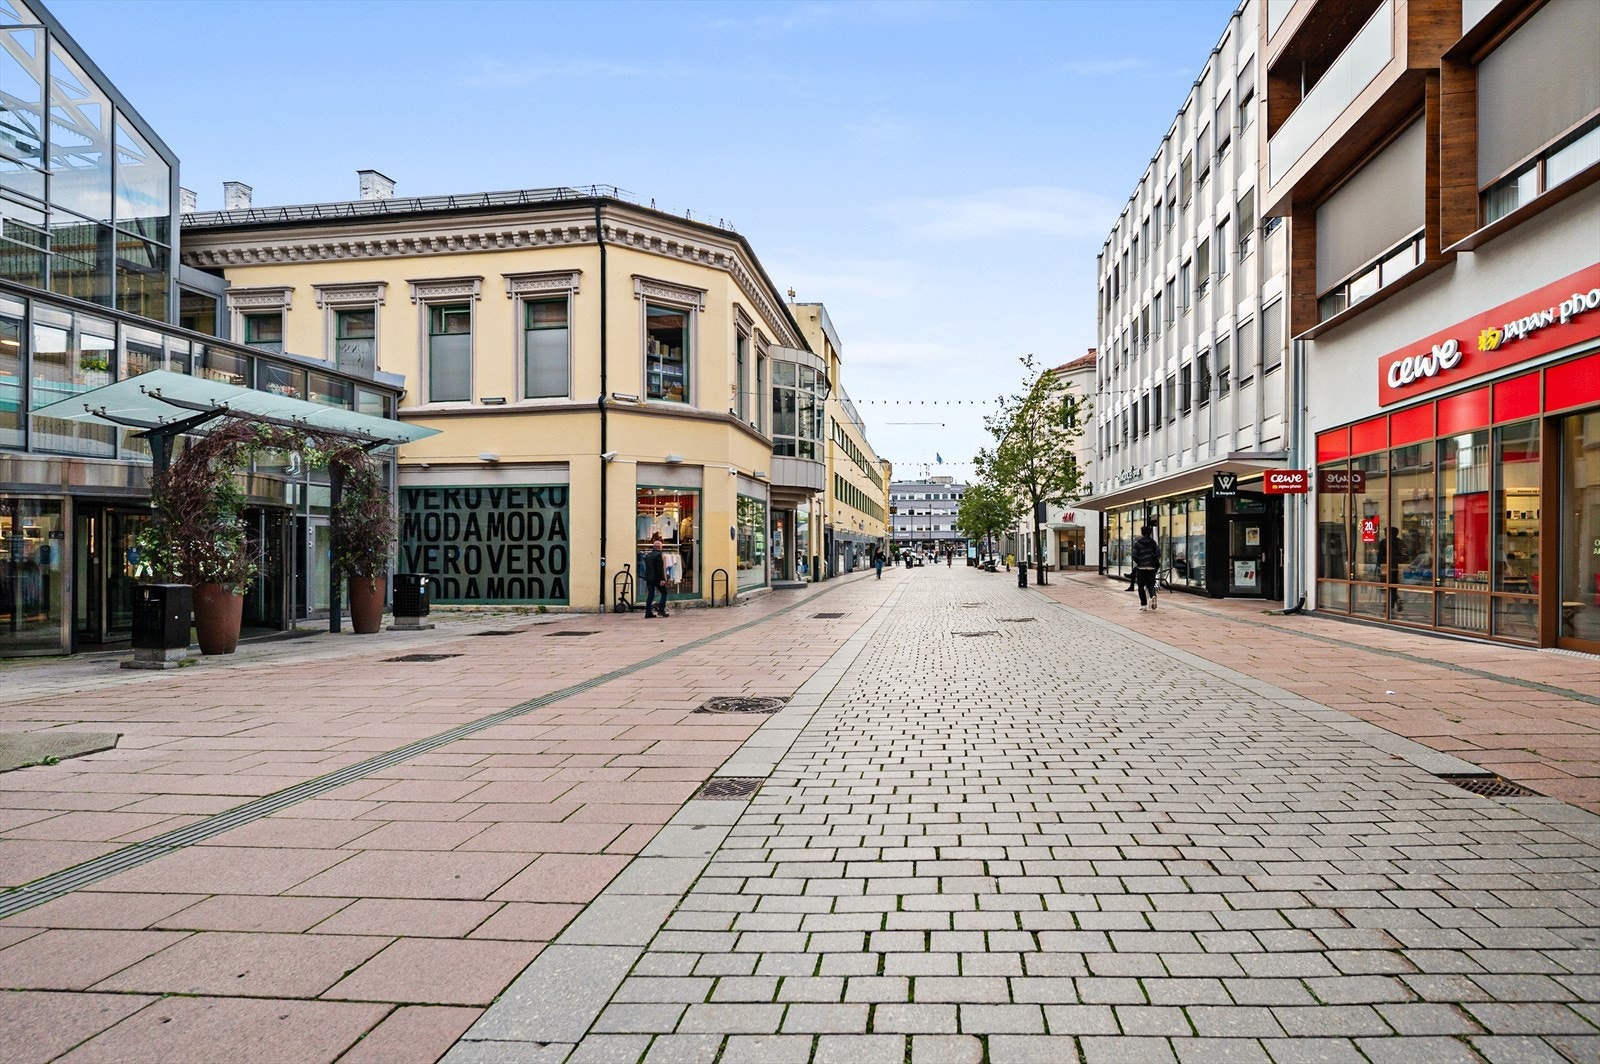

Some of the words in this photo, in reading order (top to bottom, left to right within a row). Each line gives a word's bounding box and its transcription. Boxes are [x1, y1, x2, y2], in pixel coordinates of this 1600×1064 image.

[1387, 339, 1463, 389] cewe
[1270, 474, 1304, 483] cewe
[403, 512, 483, 542] MODA
[486, 511, 567, 542] MODA
[403, 544, 482, 575] VERO
[486, 544, 567, 575] VERO
